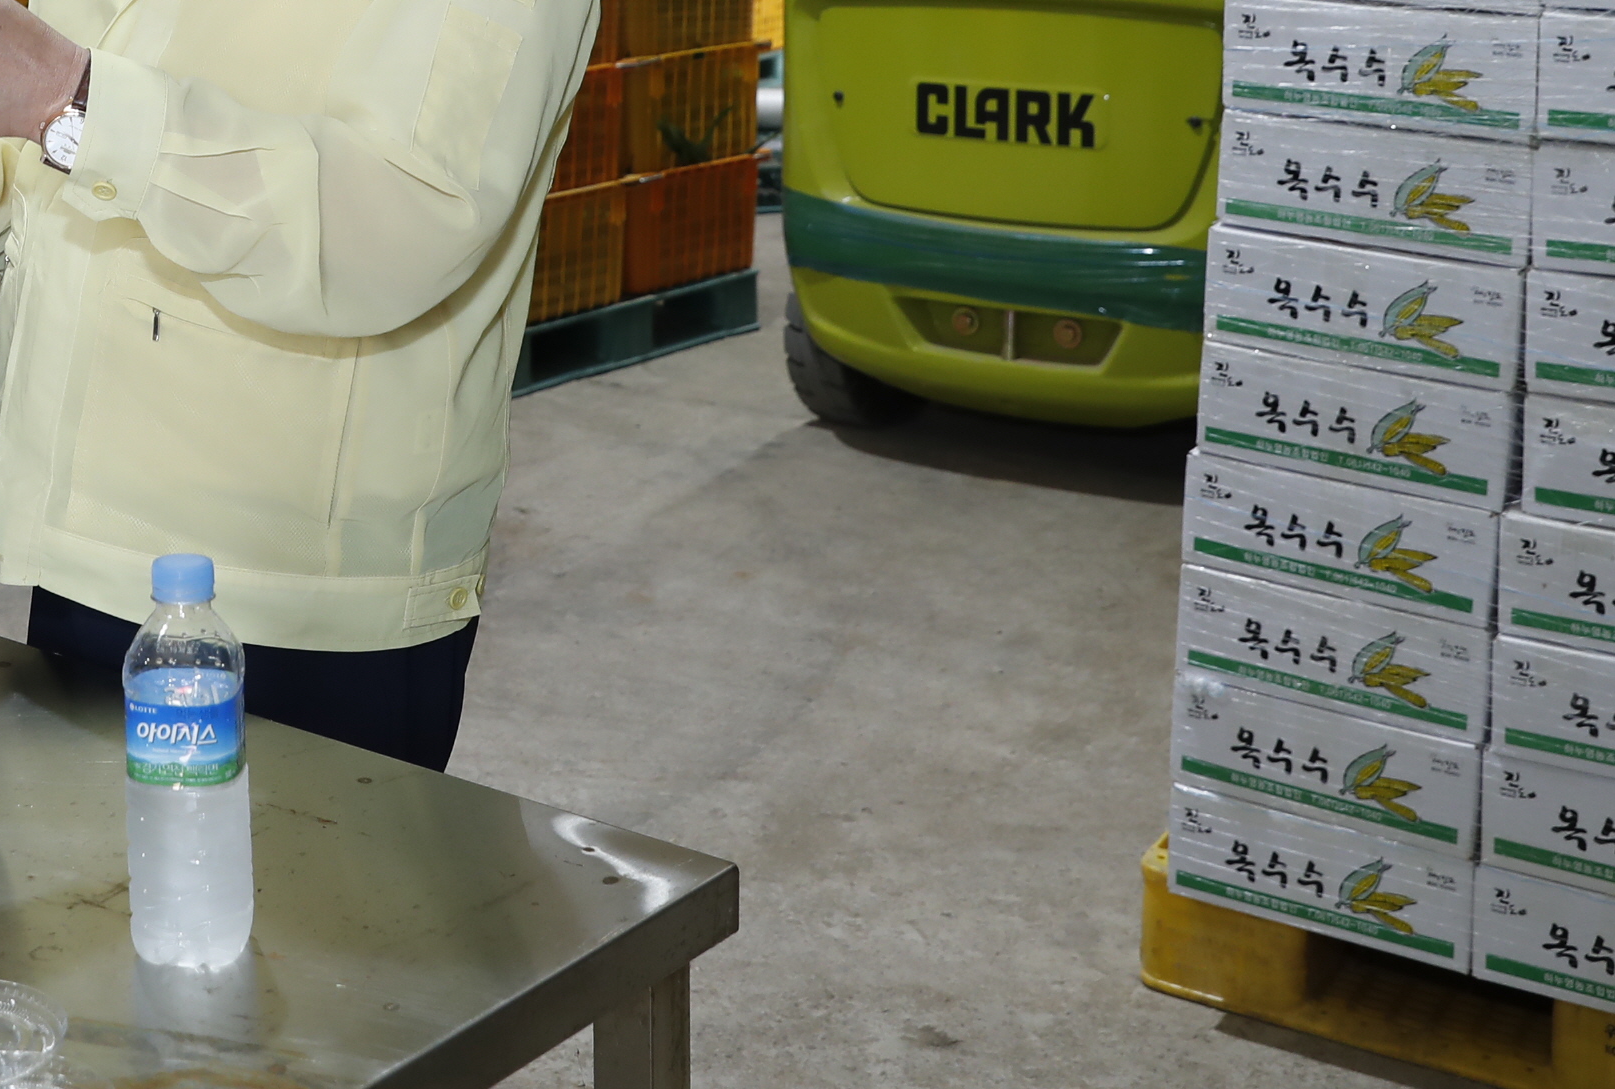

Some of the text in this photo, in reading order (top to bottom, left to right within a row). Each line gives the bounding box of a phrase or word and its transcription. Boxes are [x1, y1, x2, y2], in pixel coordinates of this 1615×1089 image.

[1283, 40, 1386, 87] 옥수수
[916, 82, 1096, 149] CLARK
[1277, 159, 1378, 208] 옥수수
[1267, 278, 1368, 330] 옥수수
[1256, 392, 1356, 446] 옥수수
[1244, 505, 1343, 560] 옥수수
[1569, 571, 1615, 615] 옥
[1235, 618, 1337, 674] 옥수수
[134, 706, 157, 714] LOTTE
[136, 722, 218, 745] 아이시스
[1227, 727, 1328, 786] 옥수수
[1223, 841, 1323, 900] 옥수수
